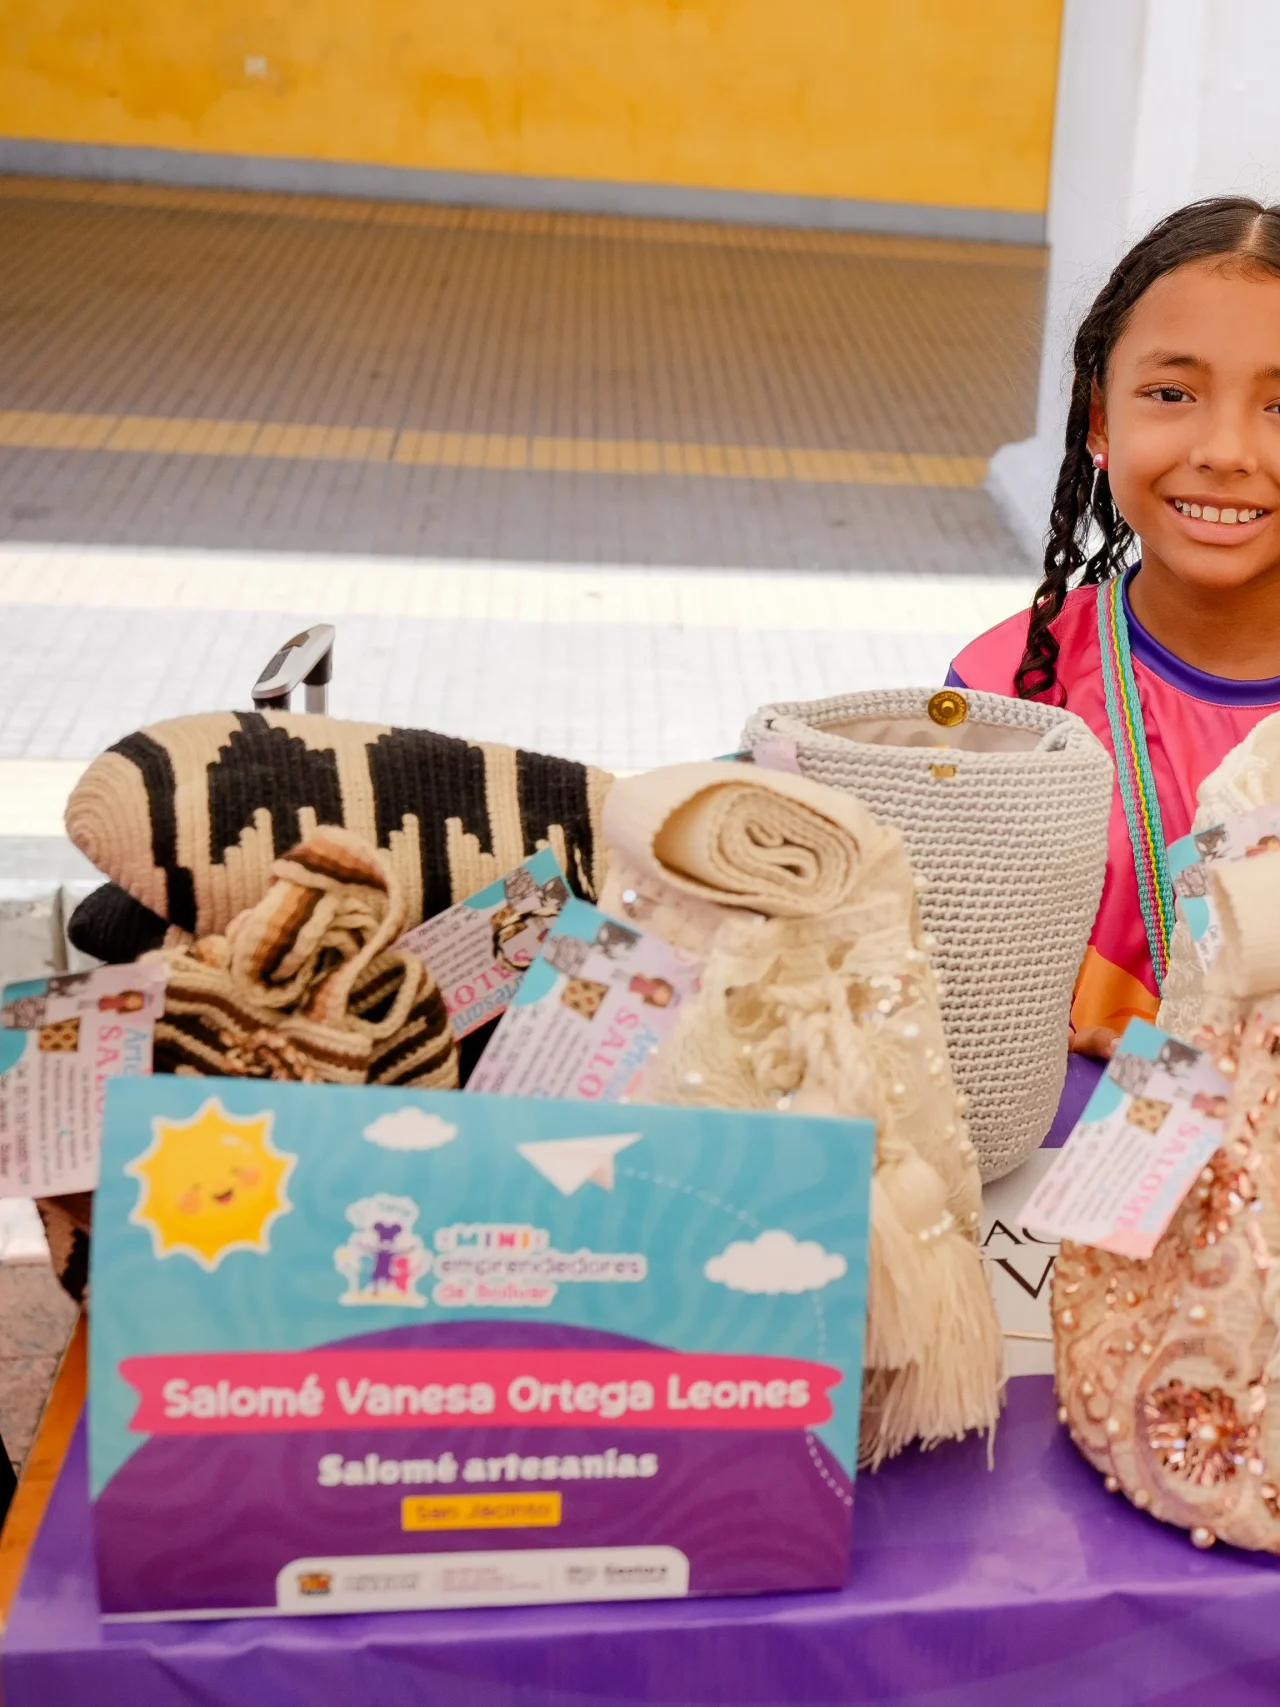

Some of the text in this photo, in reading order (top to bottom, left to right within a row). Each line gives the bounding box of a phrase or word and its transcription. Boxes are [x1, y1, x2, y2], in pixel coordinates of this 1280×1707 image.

[163, 1373, 810, 1420] Salomé Vanesa Ortega Leones
[317, 1447, 659, 1487] Salomé artesanías
